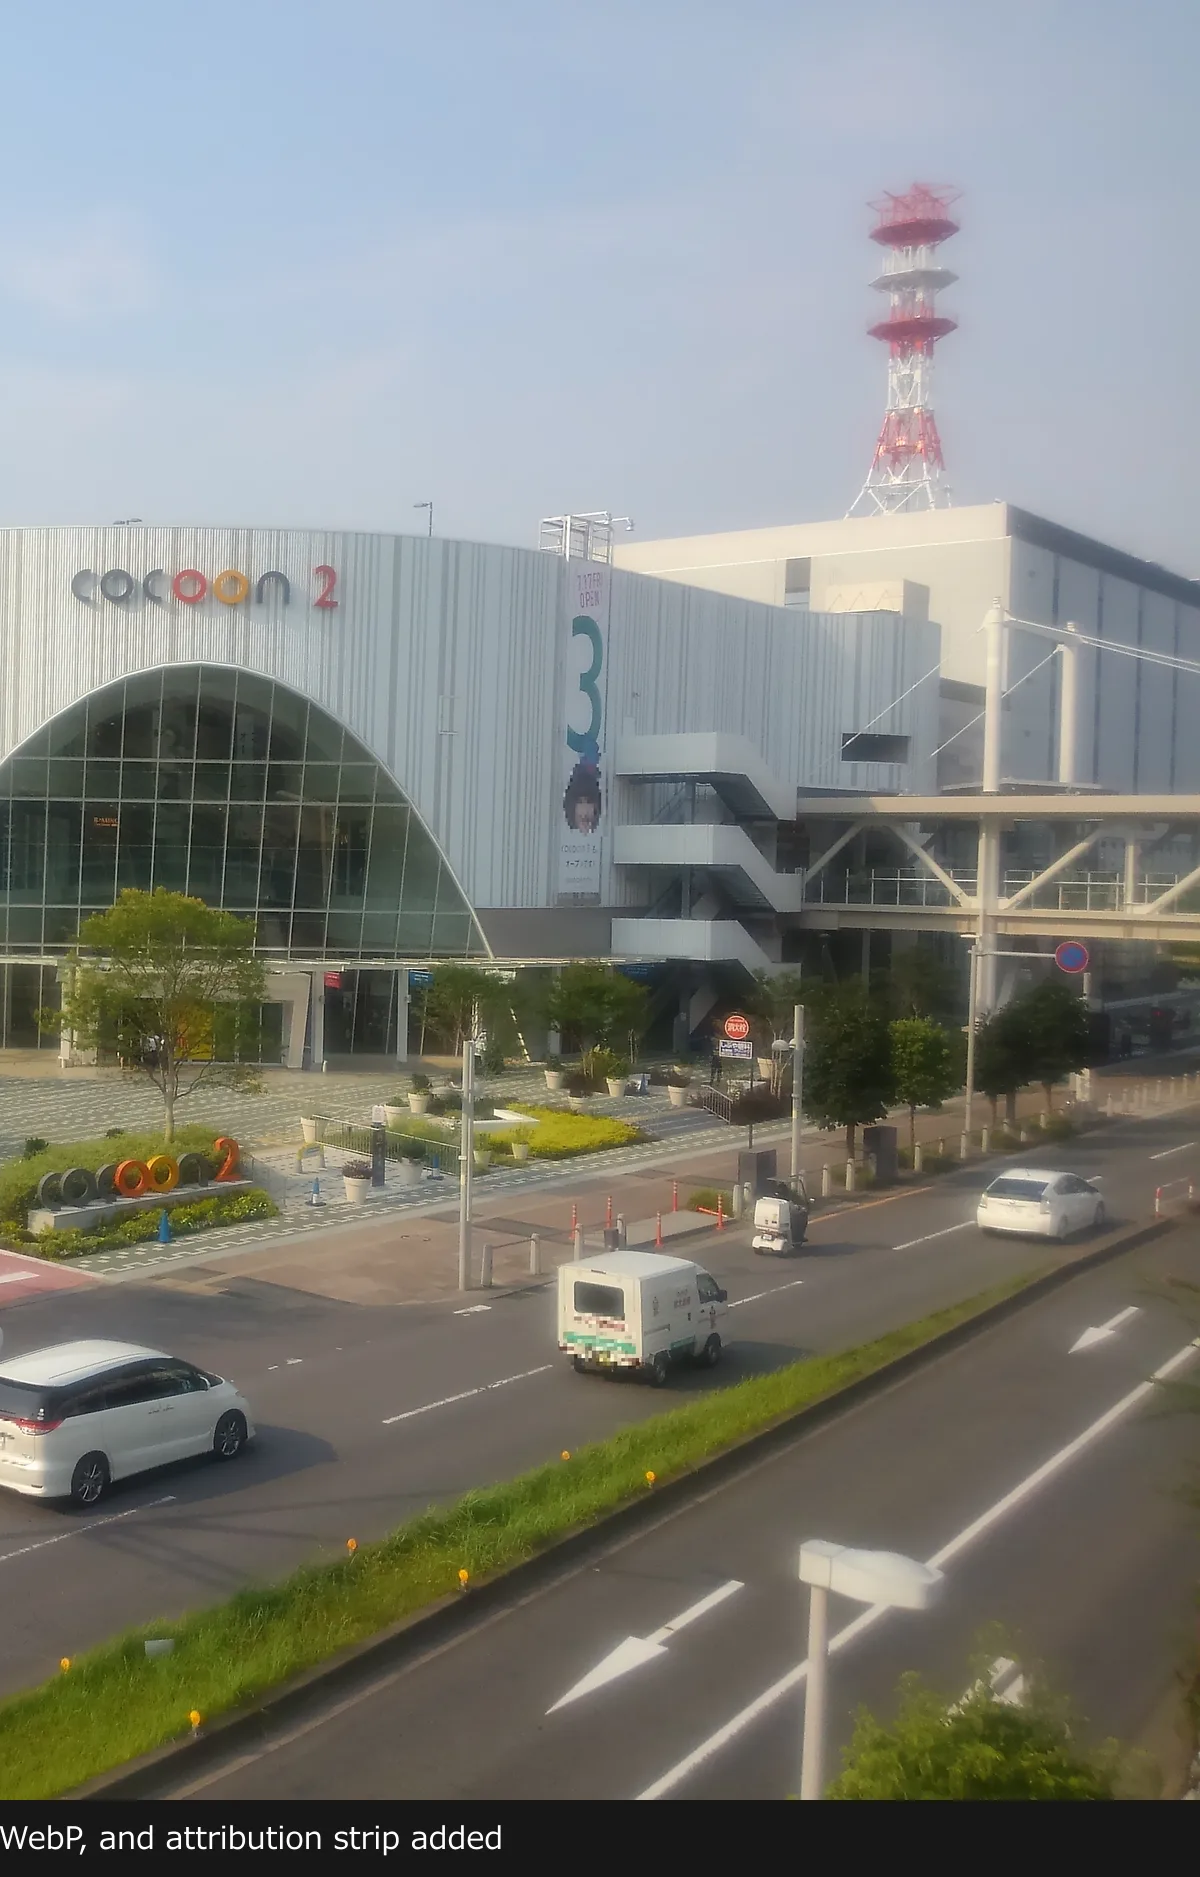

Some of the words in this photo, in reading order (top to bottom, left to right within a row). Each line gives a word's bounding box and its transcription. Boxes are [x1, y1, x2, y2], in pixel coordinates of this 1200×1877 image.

[71, 568, 291, 606] cocoon
[313, 564, 340, 608] 2
[566, 615, 603, 753] 3
[37, 1152, 209, 1211] cocoon
[213, 1136, 242, 1183] 2
